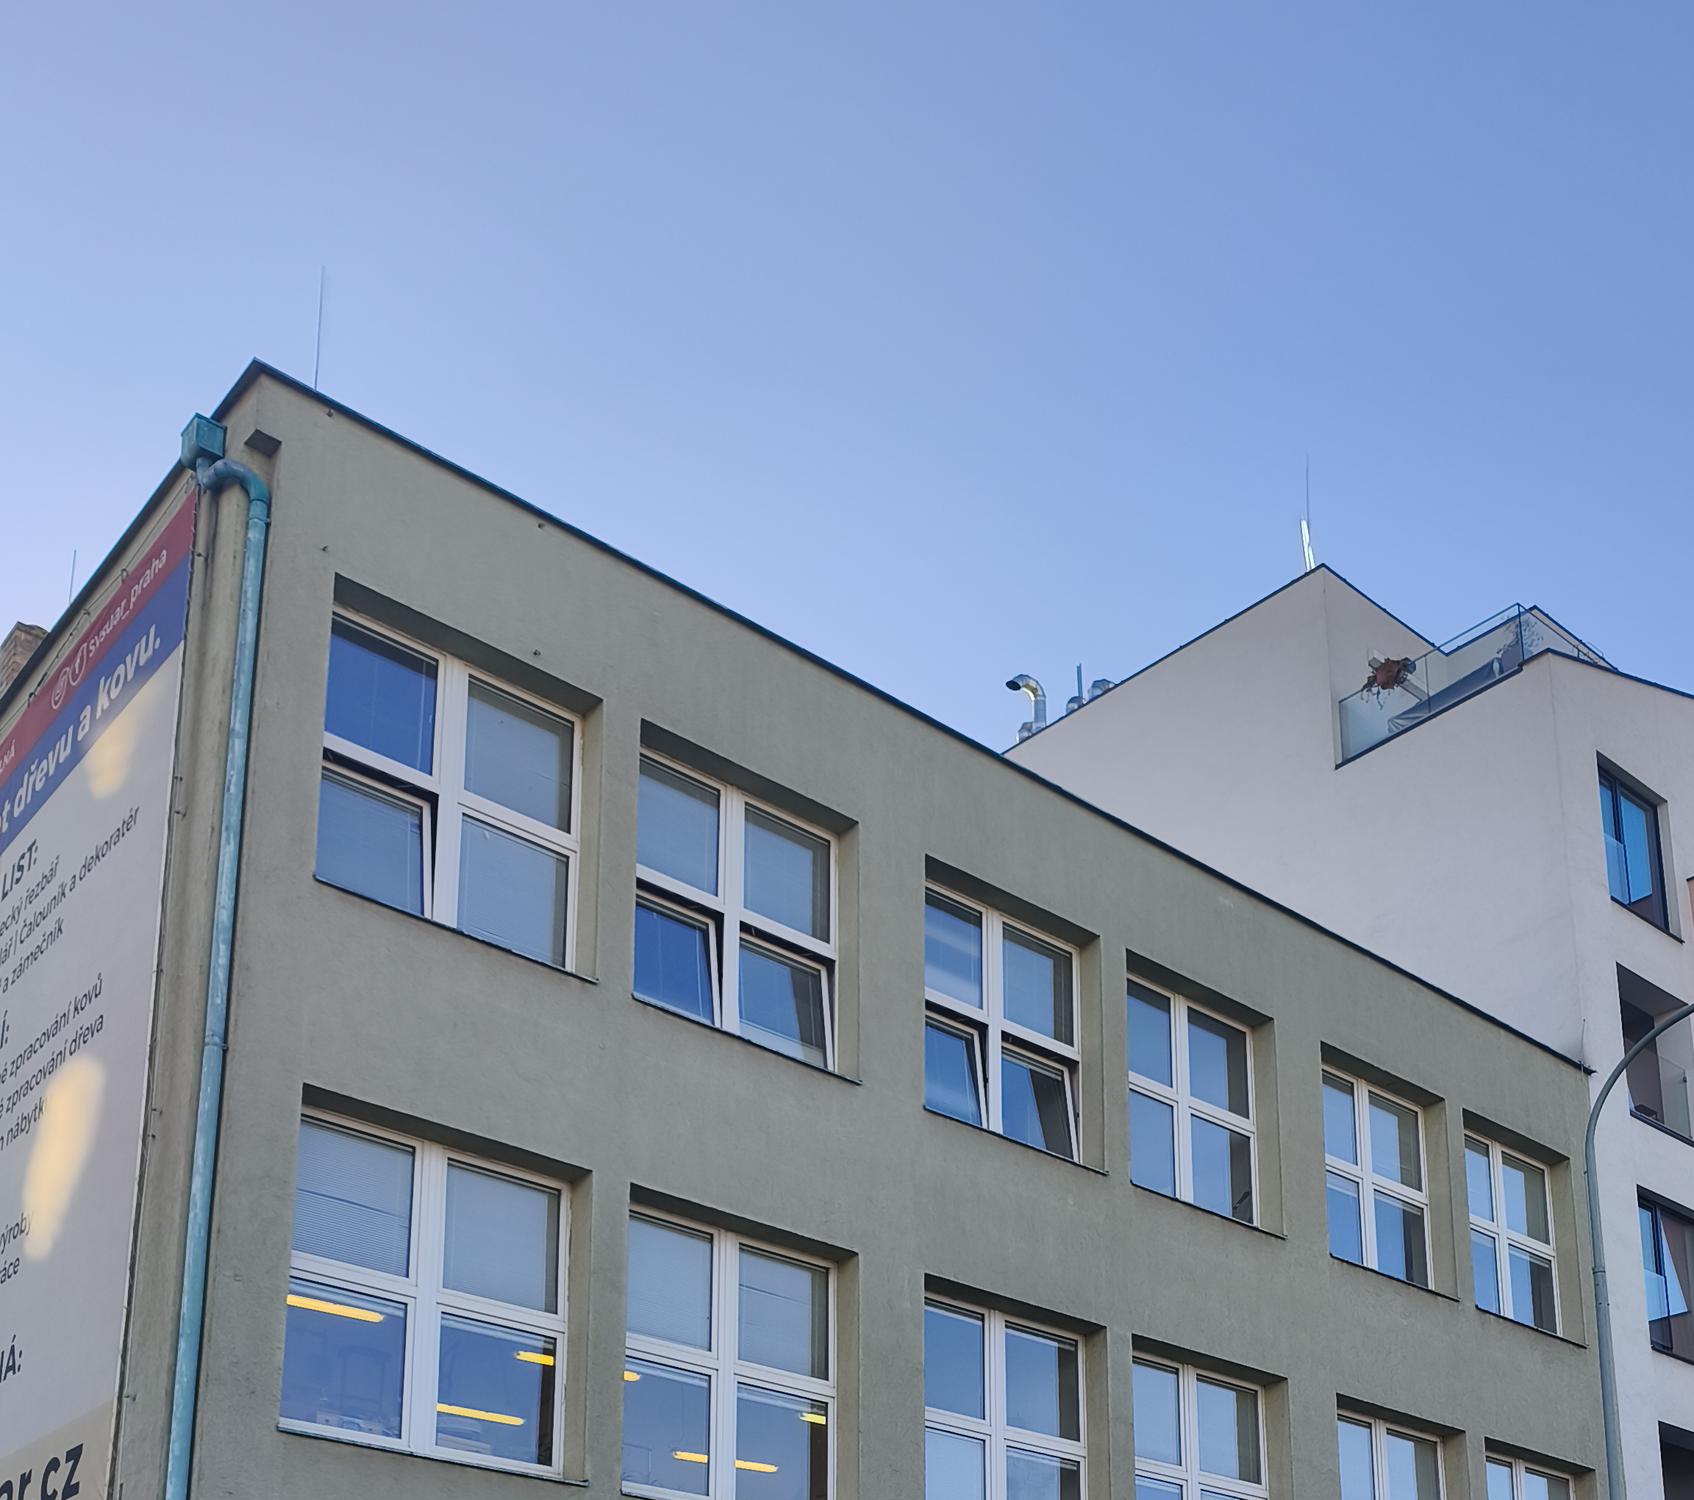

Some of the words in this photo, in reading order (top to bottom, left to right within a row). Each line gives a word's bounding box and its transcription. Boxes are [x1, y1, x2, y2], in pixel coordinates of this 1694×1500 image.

[13, 725, 74, 818] dřevu
[77, 705, 91, 742] a
[97, 624, 161, 720] kovu.
[1, 838, 39, 900] LIST:
[20, 881, 67, 945] Čalouník
[69, 874, 76, 893] a
[79, 806, 140, 882] dekoratér
[24, 854, 60, 911] řezbář
[10, 915, 64, 986] zámečník
[5, 1039, 68, 1114] zpracování
[69, 1013, 104, 1057] dřeva
[9, 1000, 72, 1079] zpracování
[73, 972, 103, 1020] kovů
